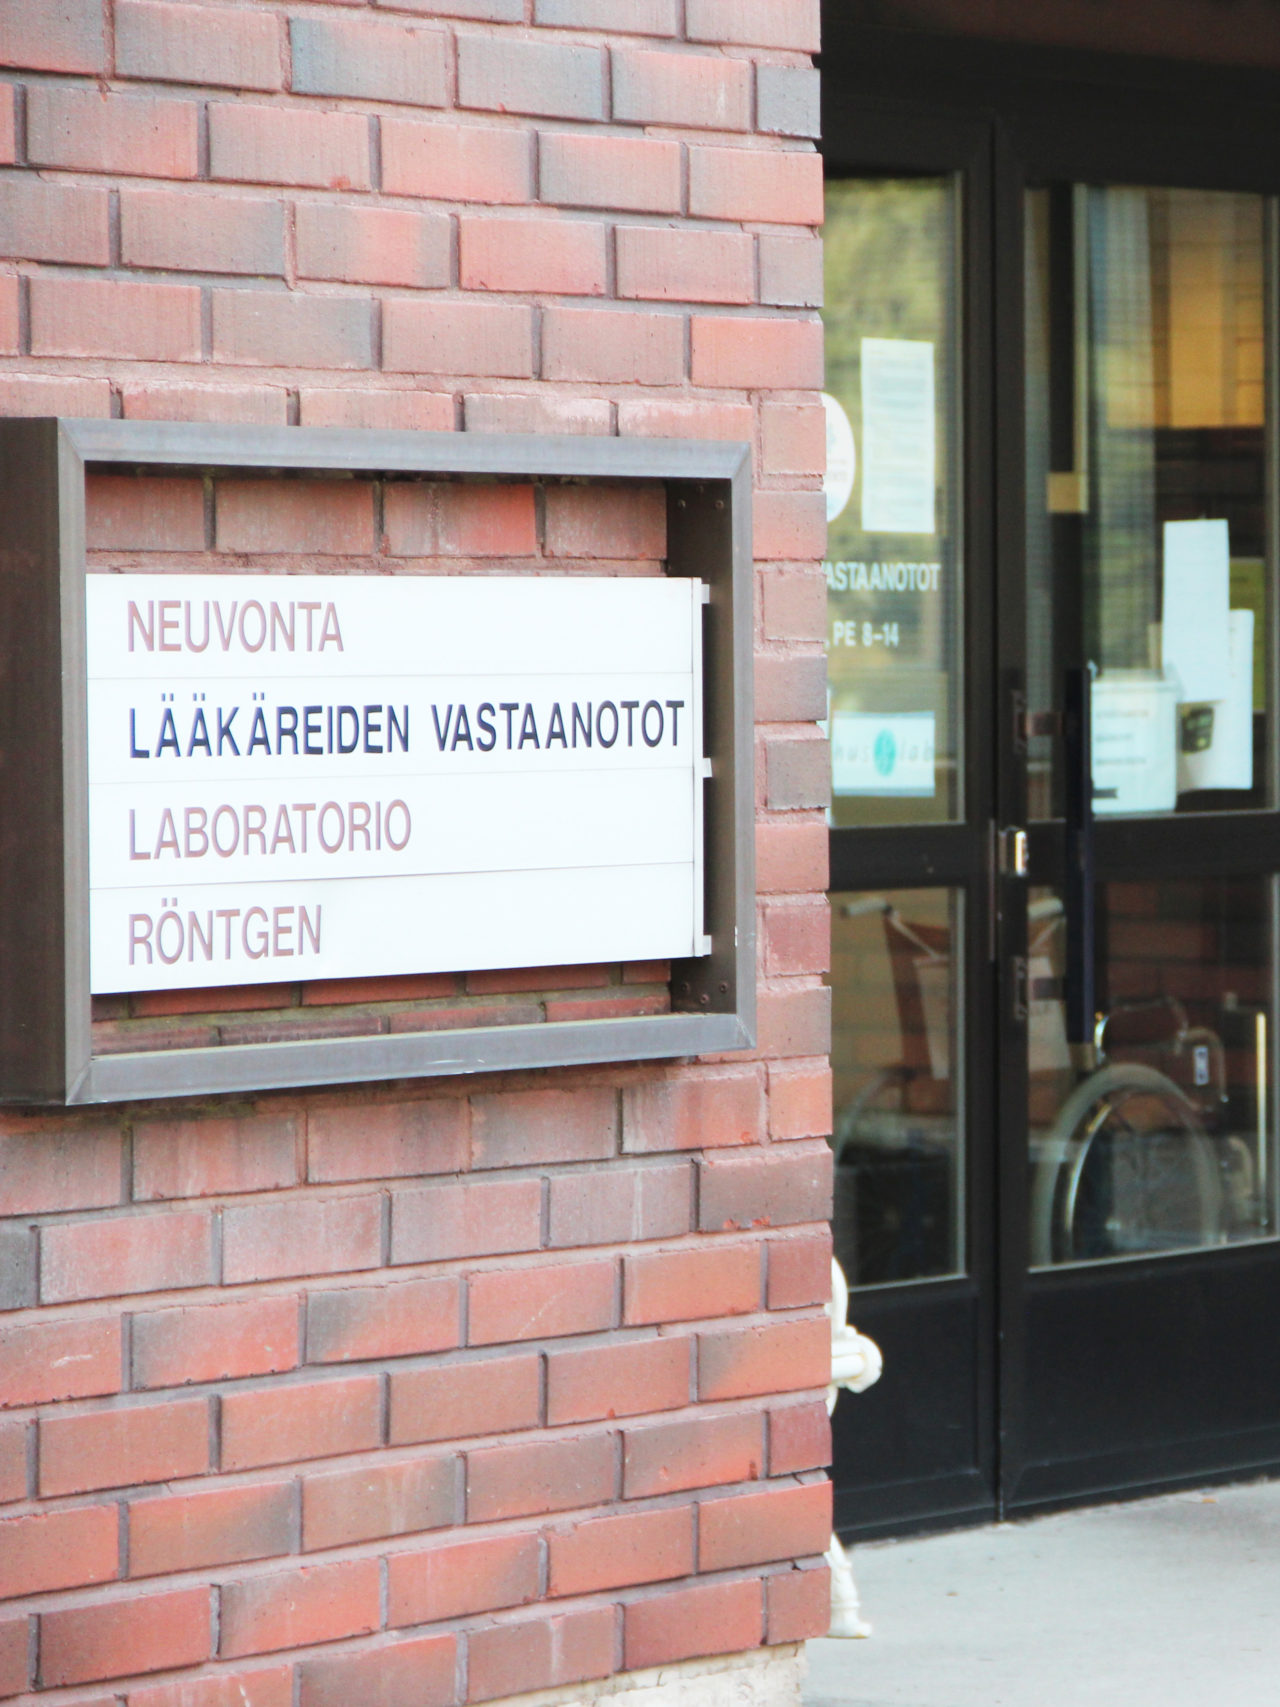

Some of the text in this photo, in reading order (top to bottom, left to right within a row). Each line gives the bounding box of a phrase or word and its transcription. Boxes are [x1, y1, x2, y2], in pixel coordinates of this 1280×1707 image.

[821, 562, 942, 592] ASTAANOTOT
[128, 600, 344, 653] NEUVONTA
[833, 621, 857, 647] PE
[129, 692, 685, 759] LÄÄKÄREIDEN VASTAANOTOT
[130, 799, 412, 861] LABORATORIO
[129, 897, 322, 965] RÖNTGEN
